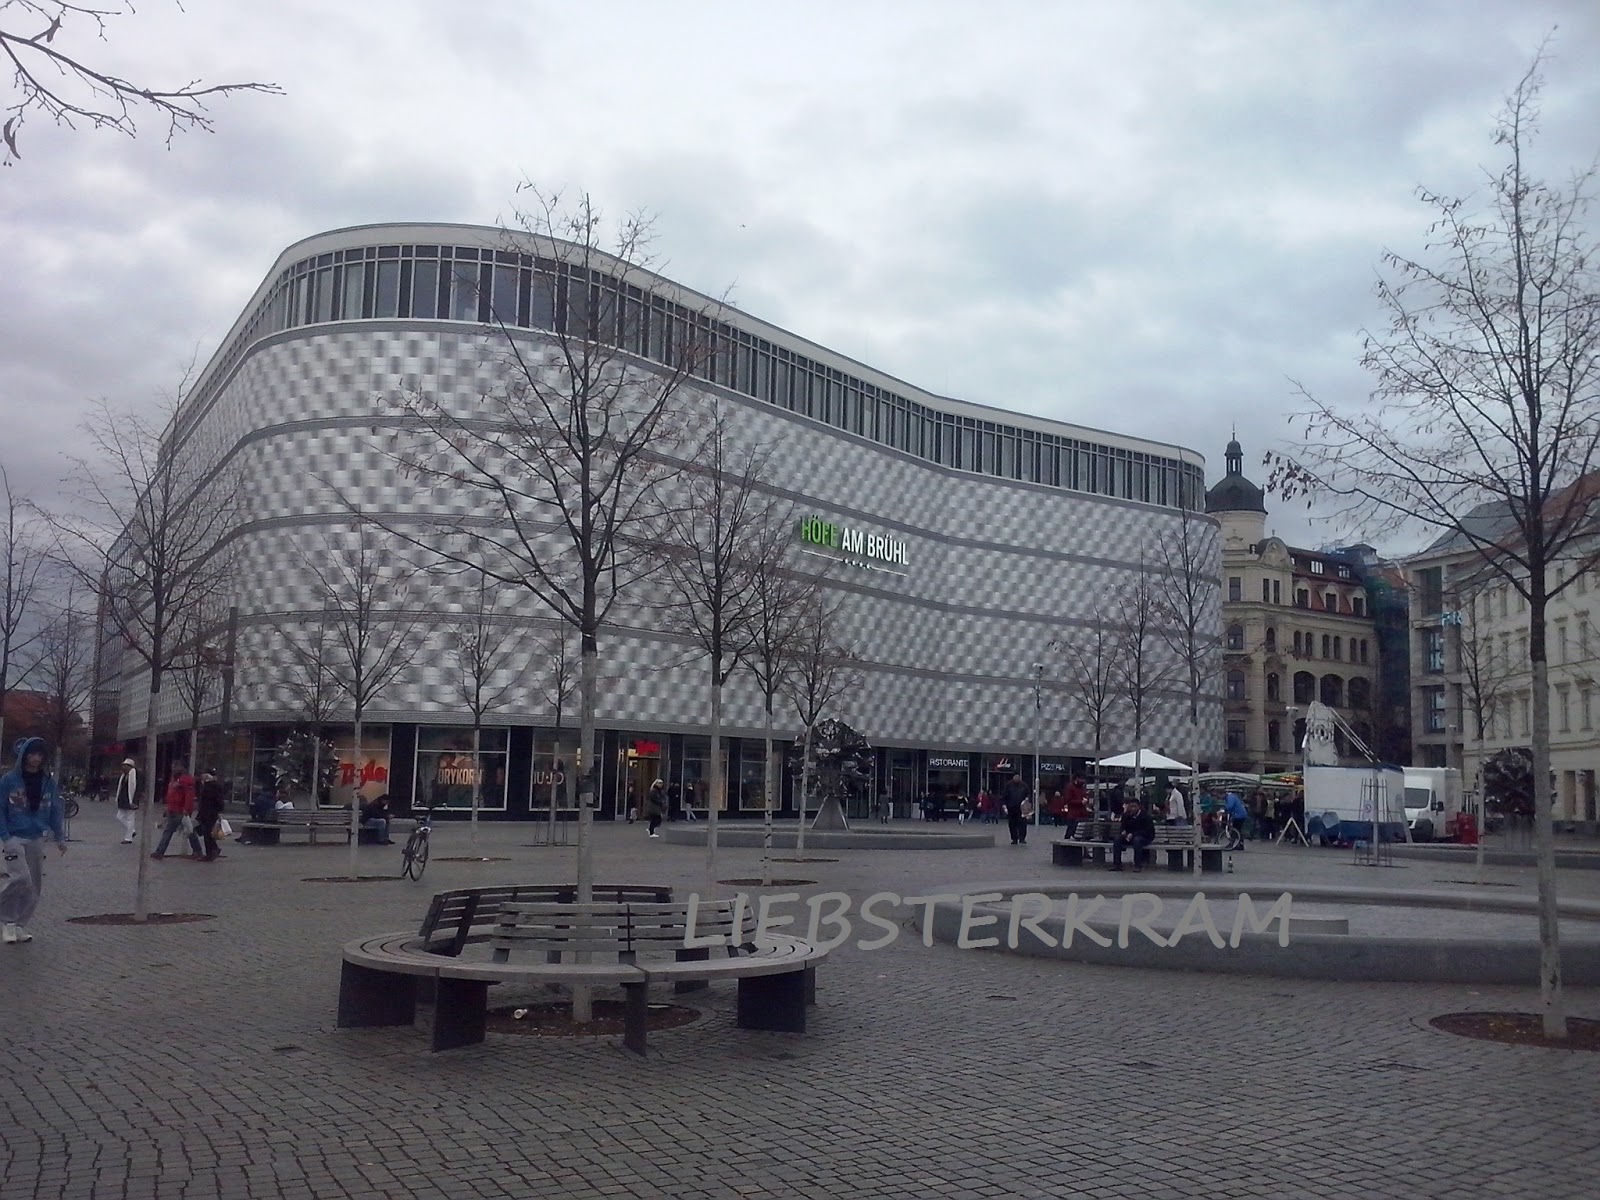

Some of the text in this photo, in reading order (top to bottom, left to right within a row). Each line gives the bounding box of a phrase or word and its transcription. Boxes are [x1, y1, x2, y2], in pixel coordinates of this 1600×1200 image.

[801, 515, 909, 565] HÖFE AM BRÜHL
[929, 758, 969, 767] RISTORANTE
